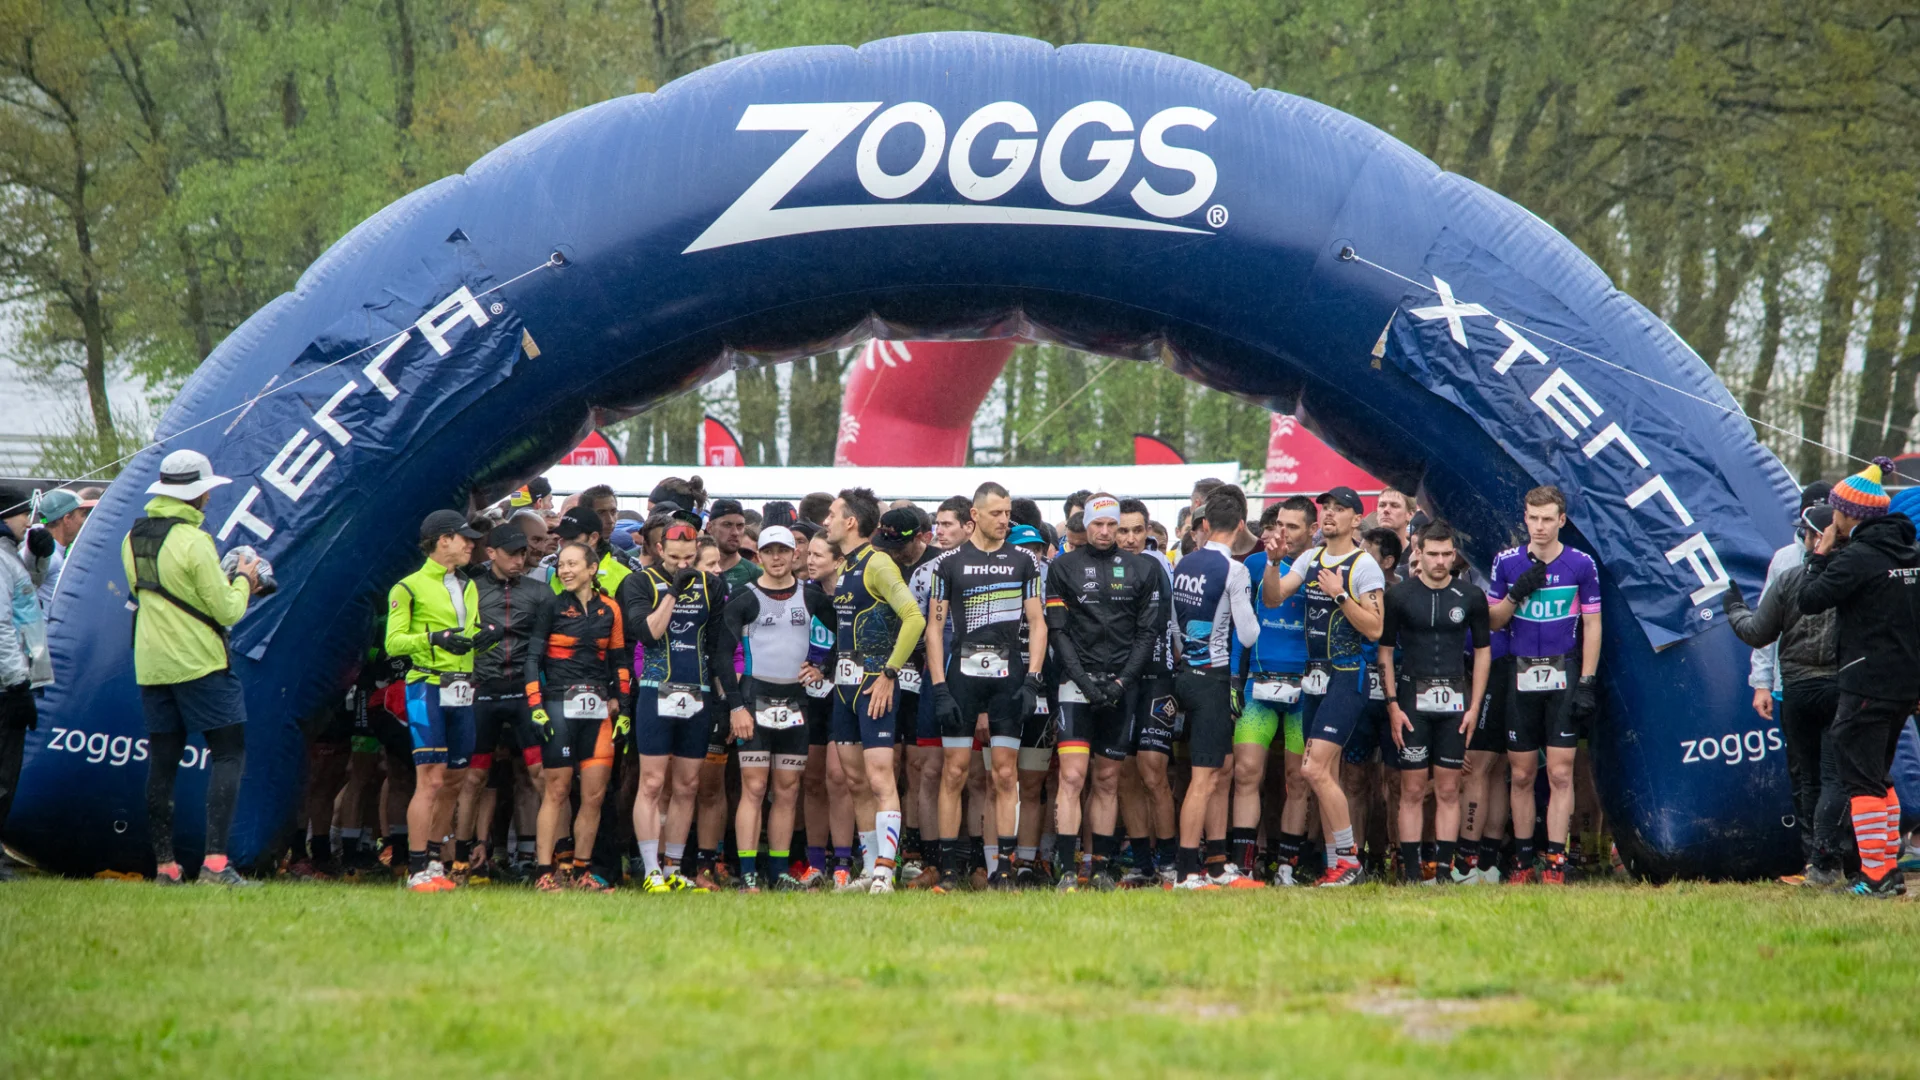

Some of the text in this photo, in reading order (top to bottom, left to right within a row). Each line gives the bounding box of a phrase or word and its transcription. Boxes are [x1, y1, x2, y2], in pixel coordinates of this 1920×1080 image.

[681, 101, 1218, 254] ZOGGS
[972, 564, 1015, 575] THOUY
[1174, 573, 1207, 595] mat
[1519, 596, 1566, 618] VOLT
[980, 656, 990, 669] 6
[839, 663, 852, 677] 15
[1533, 669, 1551, 683] 17
[454, 684, 468, 698] 12
[1273, 684, 1283, 695] 7
[579, 697, 596, 711] 19
[677, 696, 687, 709] 4
[1432, 690, 1450, 704] 10
[770, 710, 788, 722] 13
